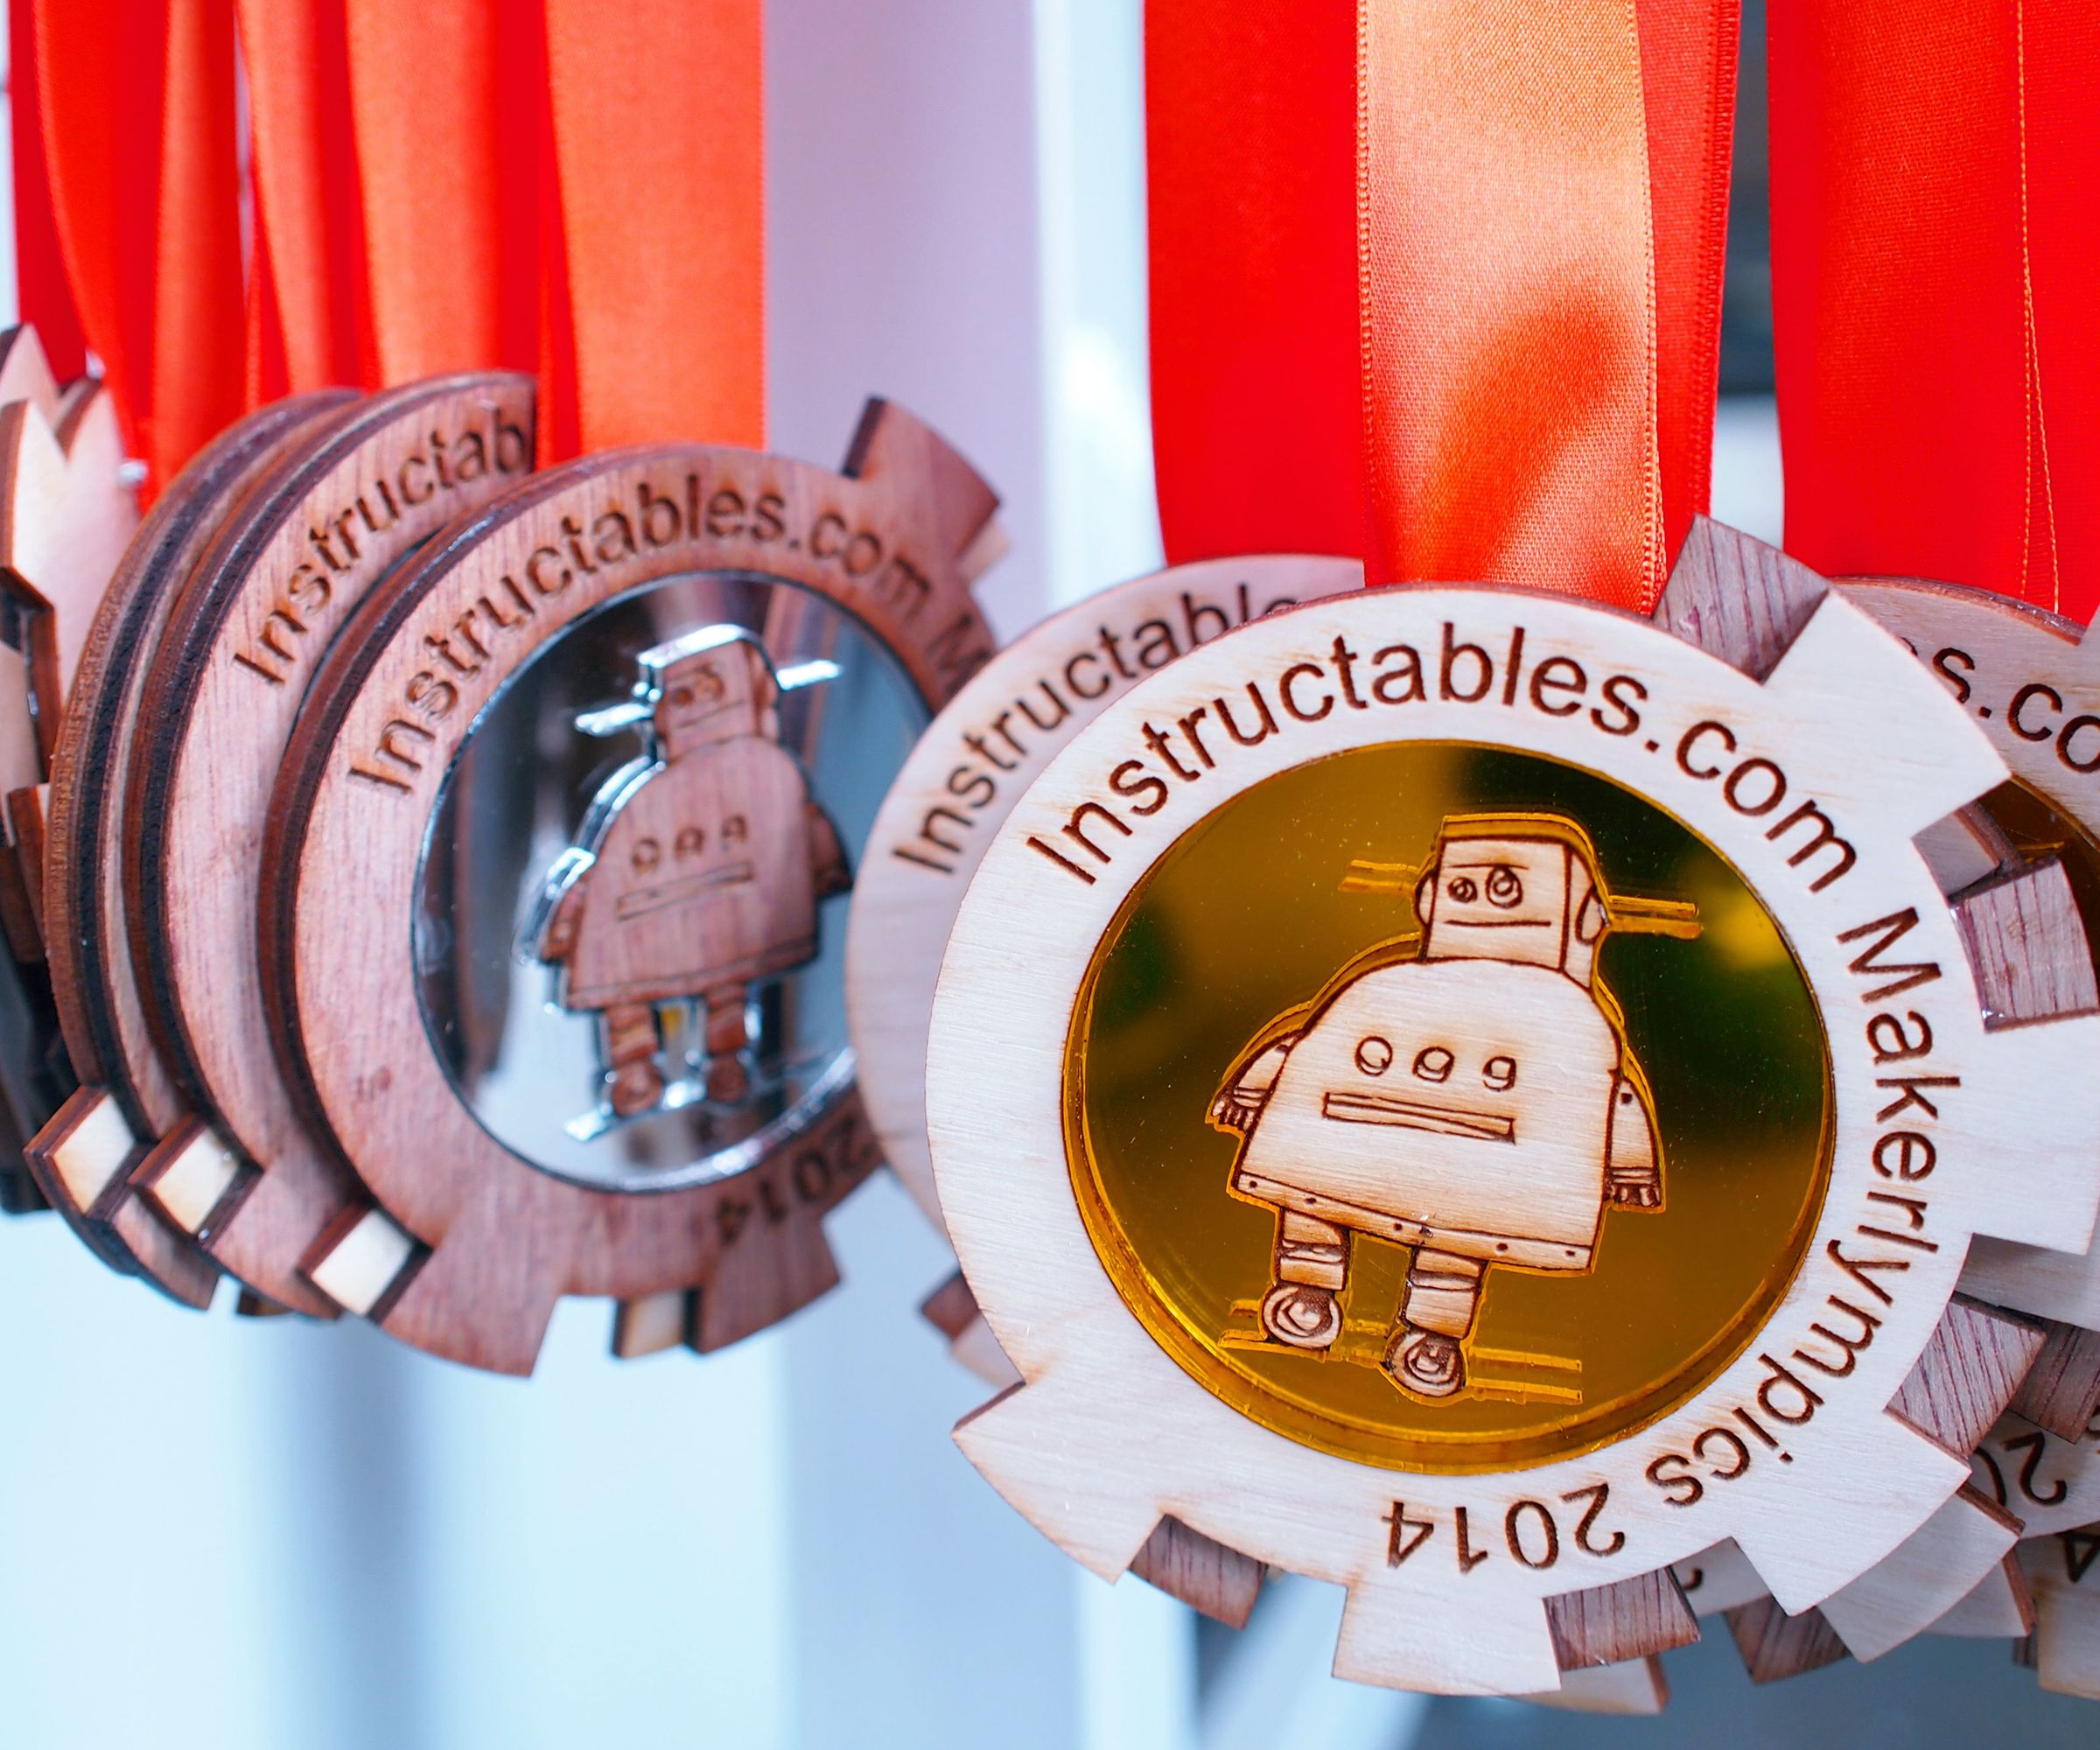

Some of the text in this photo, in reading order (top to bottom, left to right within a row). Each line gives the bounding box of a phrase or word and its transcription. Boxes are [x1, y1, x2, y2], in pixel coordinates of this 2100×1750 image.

[234, 408, 526, 686] Instructab
[350, 474, 930, 794] Instructables.com
[1026, 622, 1961, 1574] Instructables.com Makerlympics 2014
